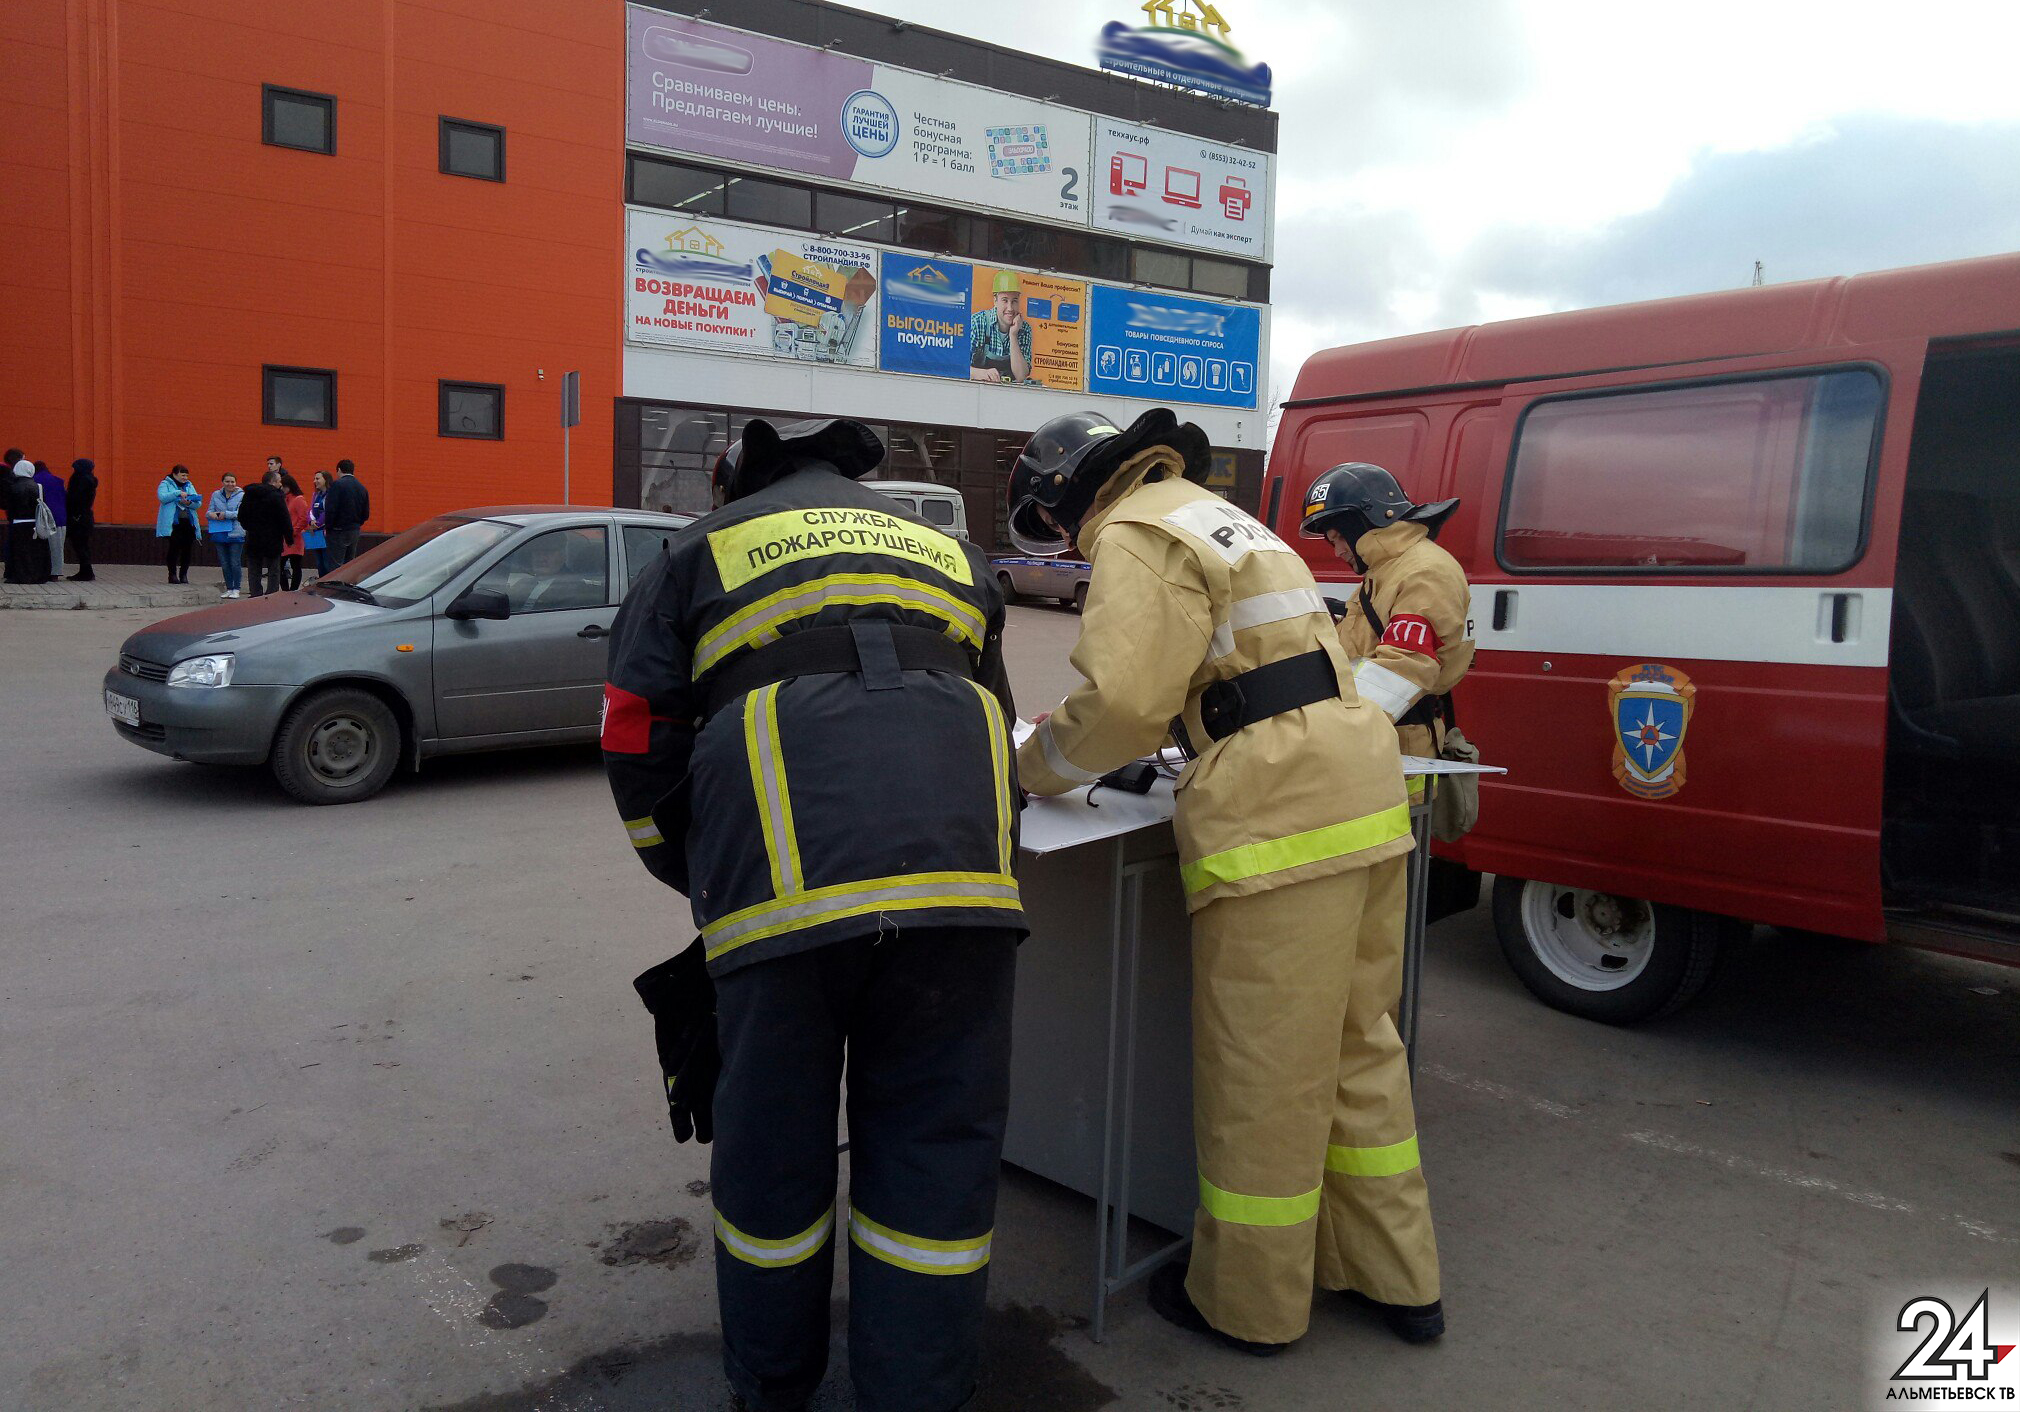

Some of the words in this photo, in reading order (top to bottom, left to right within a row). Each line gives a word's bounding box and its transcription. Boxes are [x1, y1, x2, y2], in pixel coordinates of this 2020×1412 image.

[652, 71, 752, 107] Сравниваем
[758, 97, 801, 117] цены:
[652, 91, 752, 126] Предлагаем
[756, 117, 818, 139] лучшие!
[852, 106, 889, 121] ГАРАНТИЯ
[852, 116, 889, 130] ЛУЧШЕЙ
[913, 112, 956, 131] Честная
[852, 125, 889, 143] ЦЕНЫ
[913, 126, 962, 145] бонусная
[1108, 129, 1150, 146] теххаус.рф
[913, 141, 972, 160] программа:
[913, 152, 918, 163] 1
[942, 157, 947, 168] 1
[950, 160, 975, 174] балл
[1208, 152, 1229, 164] (8553)
[1229, 155, 1256, 169] 32-42-52
[1060, 167, 1079, 202] 2
[1060, 201, 1079, 211] этаж
[1191, 225, 1212, 238] Думай
[1213, 231, 1225, 239] как
[1226, 233, 1252, 244] эксперт
[803, 253, 871, 269] СТРОЙЛАНДИЯ.РФ
[810, 244, 871, 261] 8-800-700-33-96
[635, 277, 756, 306] ВОЗВРАЩАЕМ
[663, 299, 729, 320] ДЕНЬГИ
[635, 315, 651, 326] НА
[654, 317, 693, 331] НОВЫЕ
[696, 322, 747, 337] ПОКУПКИ
[887, 314, 964, 337] ВЫГОДНЫЕ
[897, 332, 954, 349] покупки!
[1125, 330, 1149, 340] ТОВАРЫ
[1150, 333, 1200, 346] ПОВСЕДНЕВНОГО
[1201, 340, 1224, 350] СПРОСА
[803, 511, 903, 531] СЛУЖБА
[747, 529, 958, 574] ПОЖАРОТУШЕНИЯ
